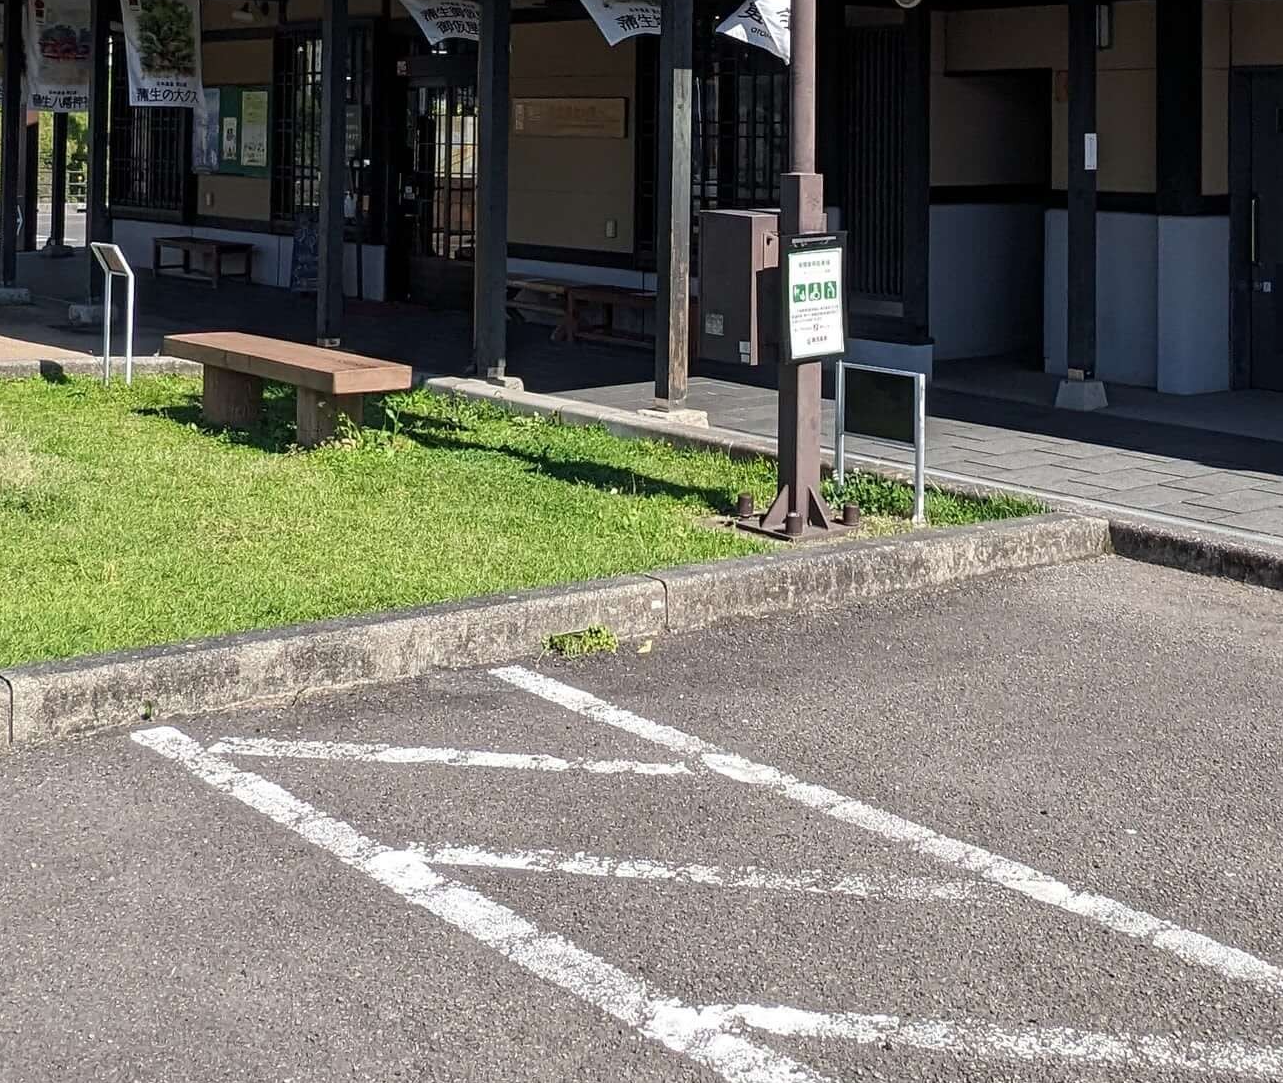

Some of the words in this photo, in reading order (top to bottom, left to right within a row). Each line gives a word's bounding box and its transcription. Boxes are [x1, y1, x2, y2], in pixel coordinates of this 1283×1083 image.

[136, 88, 199, 103] 蒲生の大クス
